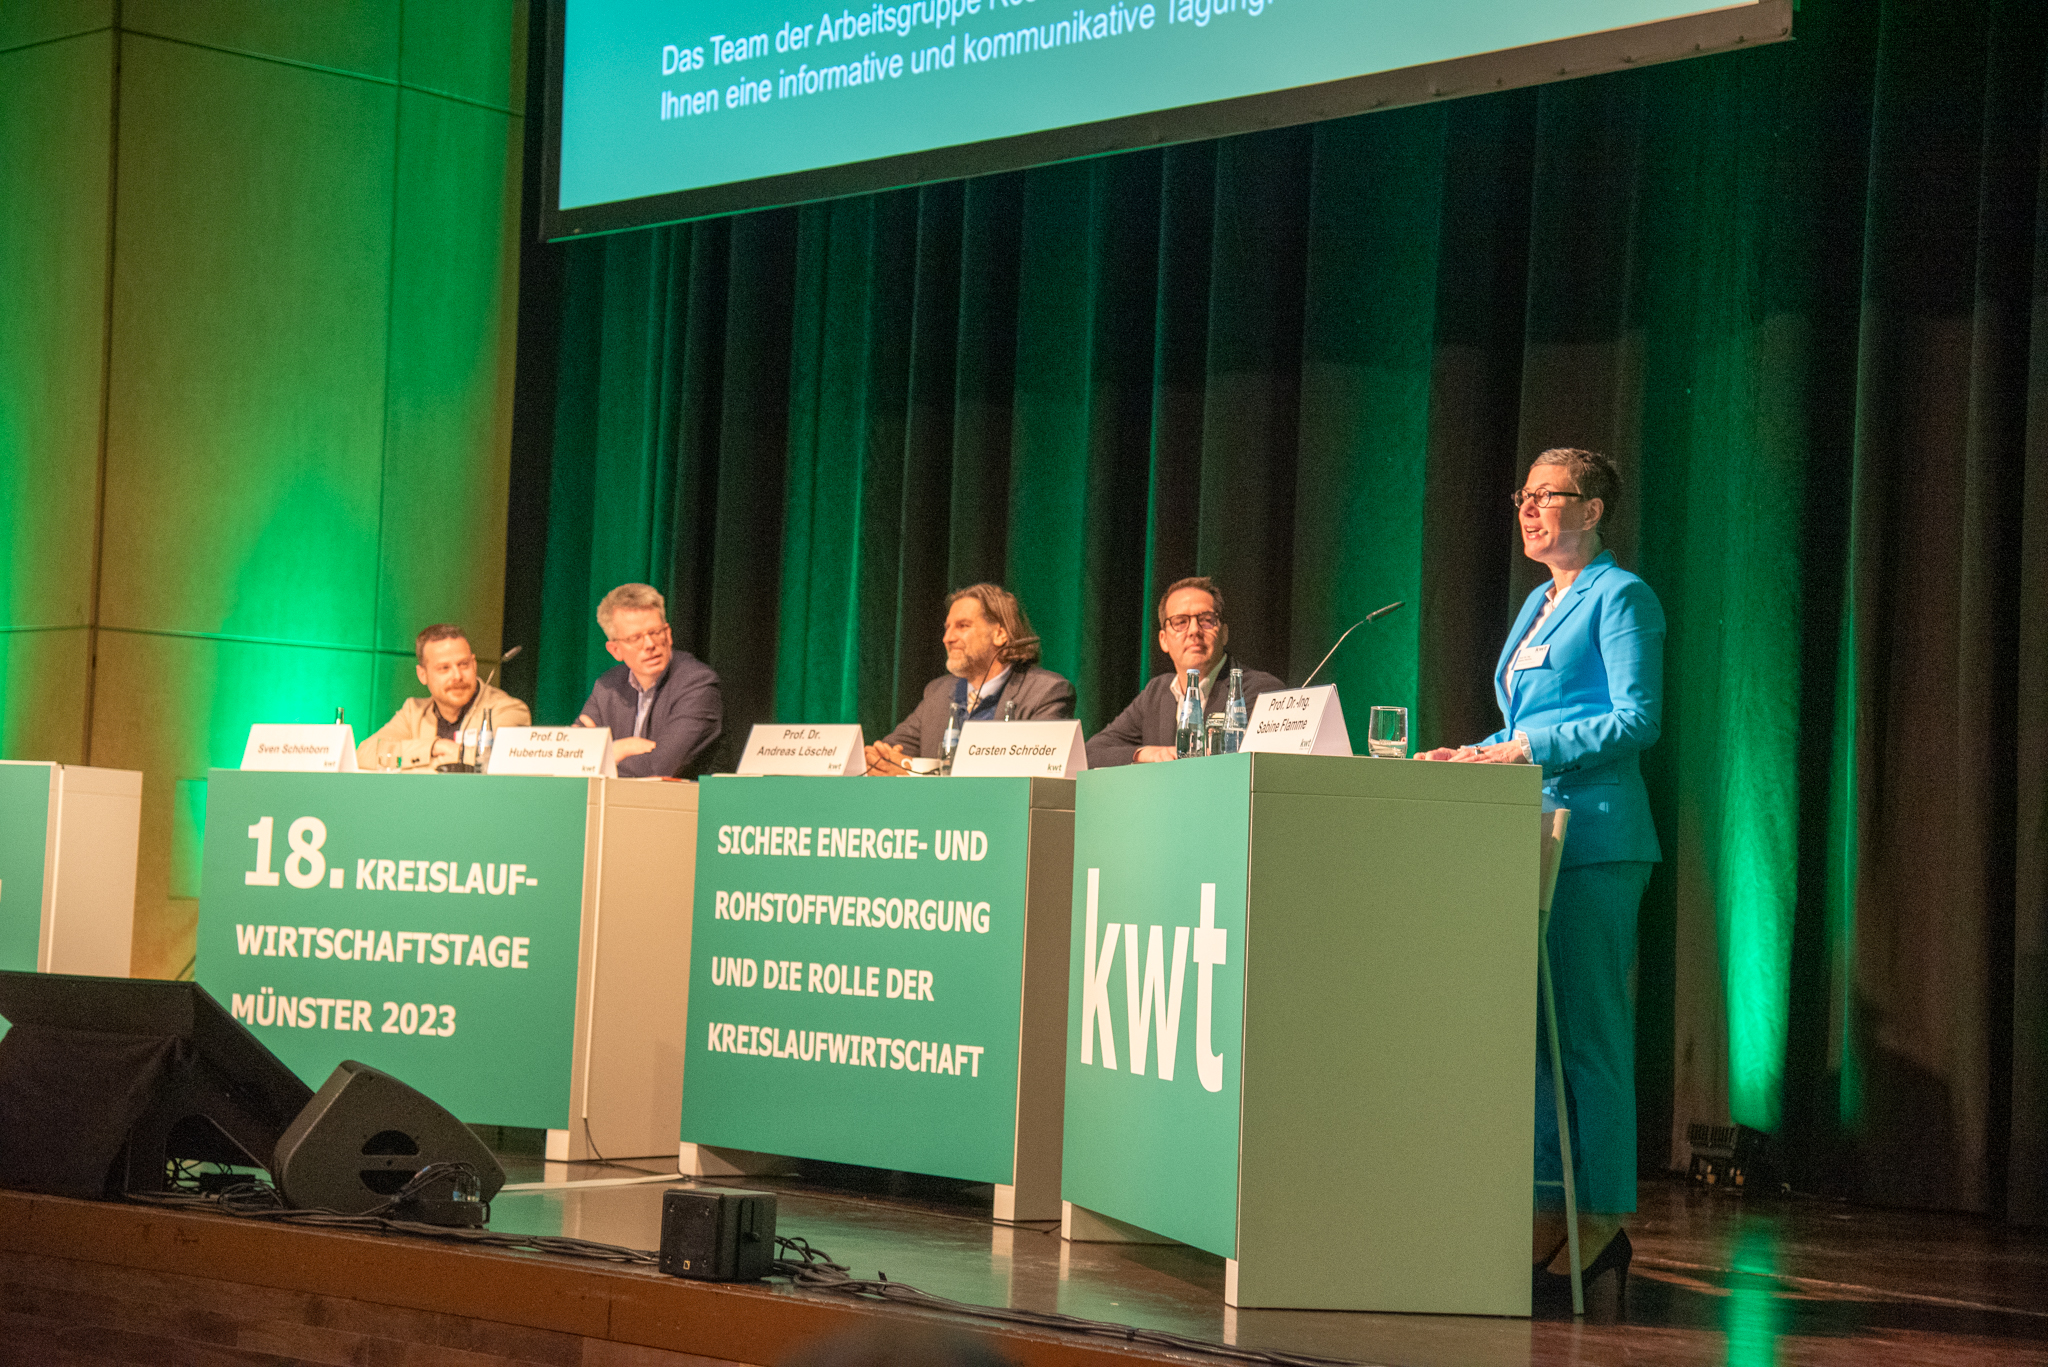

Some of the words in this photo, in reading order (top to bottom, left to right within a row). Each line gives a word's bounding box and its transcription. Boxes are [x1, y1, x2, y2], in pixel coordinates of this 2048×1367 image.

[662, 44, 704, 76] Das
[709, 33, 768, 66] Team
[775, 21, 814, 53] der
[816, 0, 981, 45] Arbeitsgruppe
[661, 89, 719, 121] Ihnen
[725, 76, 772, 109] eine
[778, 51, 903, 99] informative
[911, 36, 956, 75] und
[963, 2, 1155, 64] kommunikative
[1268, 697, 1286, 711] Prof.
[530, 731, 552, 742] Prof.
[556, 731, 569, 742] Dr.
[783, 729, 805, 740] Prof.
[808, 729, 821, 740] Dr.
[1256, 720, 1280, 734] Sabine
[1280, 718, 1307, 733] Flamme
[258, 743, 279, 754] Sven
[282, 743, 329, 754] Schönborn
[509, 747, 553, 758] Hubertus
[556, 748, 584, 759] Bardt
[757, 746, 796, 756] Andreas
[798, 746, 837, 756] Löschel
[968, 744, 1006, 756] Carsten
[1009, 744, 1056, 756] Schröder
[1047, 763, 1062, 771] kwt
[244, 816, 345, 889] 18.
[356, 858, 538, 896] KREISLAUF-
[717, 824, 812, 856] SICHERE
[817, 827, 928, 859] ENERGIE-
[934, 829, 988, 861] UND
[715, 890, 991, 934] ROHSTOFFVERSORGUNG
[235, 923, 531, 969] WIRTSCHAFTSTAGE
[711, 956, 758, 988] UND
[763, 959, 803, 992] DIE
[808, 962, 880, 997] ROLLE
[886, 968, 935, 1001] DER
[1081, 867, 1228, 1093] kwt
[231, 986, 374, 1032] MÜNSTER
[381, 1001, 457, 1037] 2023
[707, 1021, 984, 1078] KREISLAUFWIRTSCHAFT
